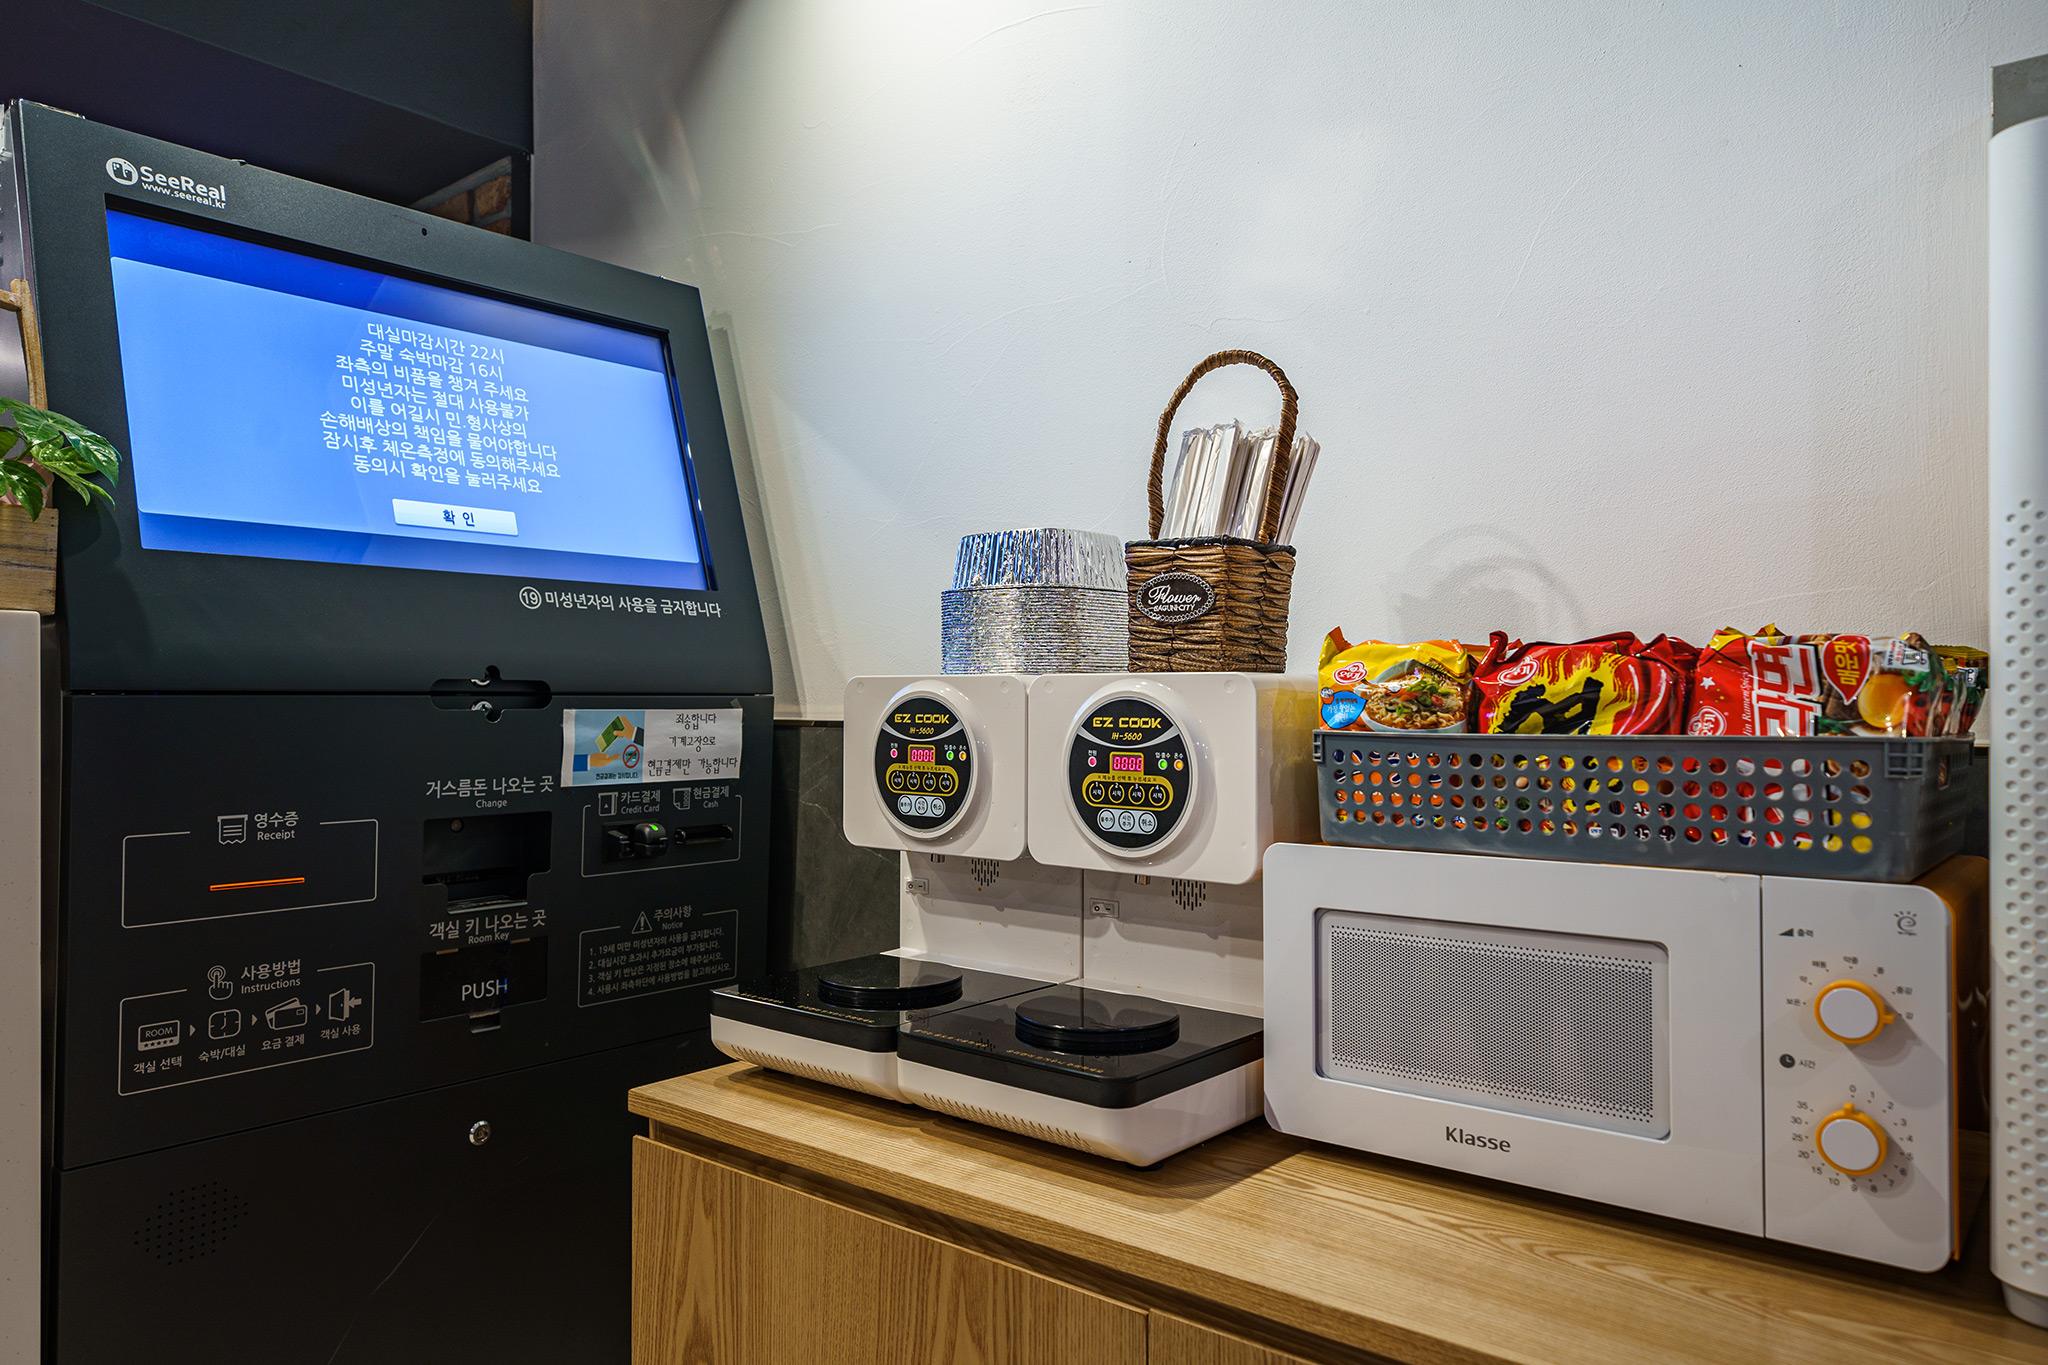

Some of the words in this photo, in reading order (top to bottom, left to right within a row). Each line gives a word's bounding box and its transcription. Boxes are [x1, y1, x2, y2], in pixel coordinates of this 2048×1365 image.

[140, 166, 226, 201] SeeReal
[142, 182, 226, 209] www.seereal.kr
[368, 322, 465, 357] 대실마감시간
[470, 345, 505, 364] 22시
[360, 340, 394, 360] 주말
[399, 347, 463, 374] 숙박마감
[469, 363, 503, 382] 16시
[335, 354, 388, 378] 좌측의
[394, 365, 442, 388] 비품을
[448, 375, 479, 394] 챙겨
[483, 382, 529, 402] 주세요
[342, 375, 427, 405] 미성년자는
[432, 390, 464, 410] 절대
[470, 398, 529, 421] 사용불가
[351, 396, 385, 415] 이를
[390, 403, 440, 425] 어길시
[320, 410, 408, 439] 손해배상의
[414, 424, 462, 447] 책임을
[467, 434, 557, 461] 물어야합니다
[323, 431, 377, 454] 잠시후
[383, 440, 465, 466] 체온측정에
[470, 452, 560, 478] 동의해주세요
[353, 455, 405, 478] 동의시
[411, 462, 460, 484] 확인을
[465, 471, 542, 493] 눌러주세요
[1148, 584, 1201, 605] Flower
[545, 591, 614, 611] 미성년자의
[619, 597, 657, 614] 사용을
[661, 599, 722, 617] 금지합니다
[1834, 640, 1860, 685] 매운맛
[676, 713, 717, 730] 죄송합니다
[894, 713, 911, 723] EZ
[915, 714, 950, 724] COOK
[1092, 717, 1114, 728] EZ
[1119, 718, 1161, 728] COOK
[1112, 732, 1142, 740] IH-5600
[698, 758, 737, 774] 가능합니다
[426, 778, 488, 799] 거스름돈
[492, 777, 536, 795] 나오는
[540, 775, 554, 792] 곳
[693, 786, 729, 799] 현금결제
[475, 799, 508, 809] Change
[621, 790, 661, 804] 카드결제
[621, 806, 642, 814] Credit
[254, 811, 299, 828] 영수증
[257, 830, 296, 840] Receipt
[653, 905, 693, 921] 주의사항
[429, 920, 460, 940] 객실
[466, 918, 480, 935] 키
[485, 912, 529, 933] 나오는
[532, 909, 547, 927] 곳
[662, 922, 683, 930] Notice
[468, 933, 492, 944] Room
[494, 931, 509, 942] Key
[241, 959, 301, 981] 사용방법
[241, 978, 301, 994] Instructions
[462, 978, 508, 1001] PUSH
[145, 1026, 174, 1038] ROOM
[320, 1028, 339, 1039] 객실
[342, 1024, 361, 1037] 사용
[261, 1038, 282, 1051] 요금
[285, 1034, 305, 1047] 결제
[199, 1044, 246, 1062] 숙박/대실
[134, 1060, 156, 1074] 객실
[160, 1056, 182, 1071] 선택
[1446, 1126, 1511, 1153] Klasse
